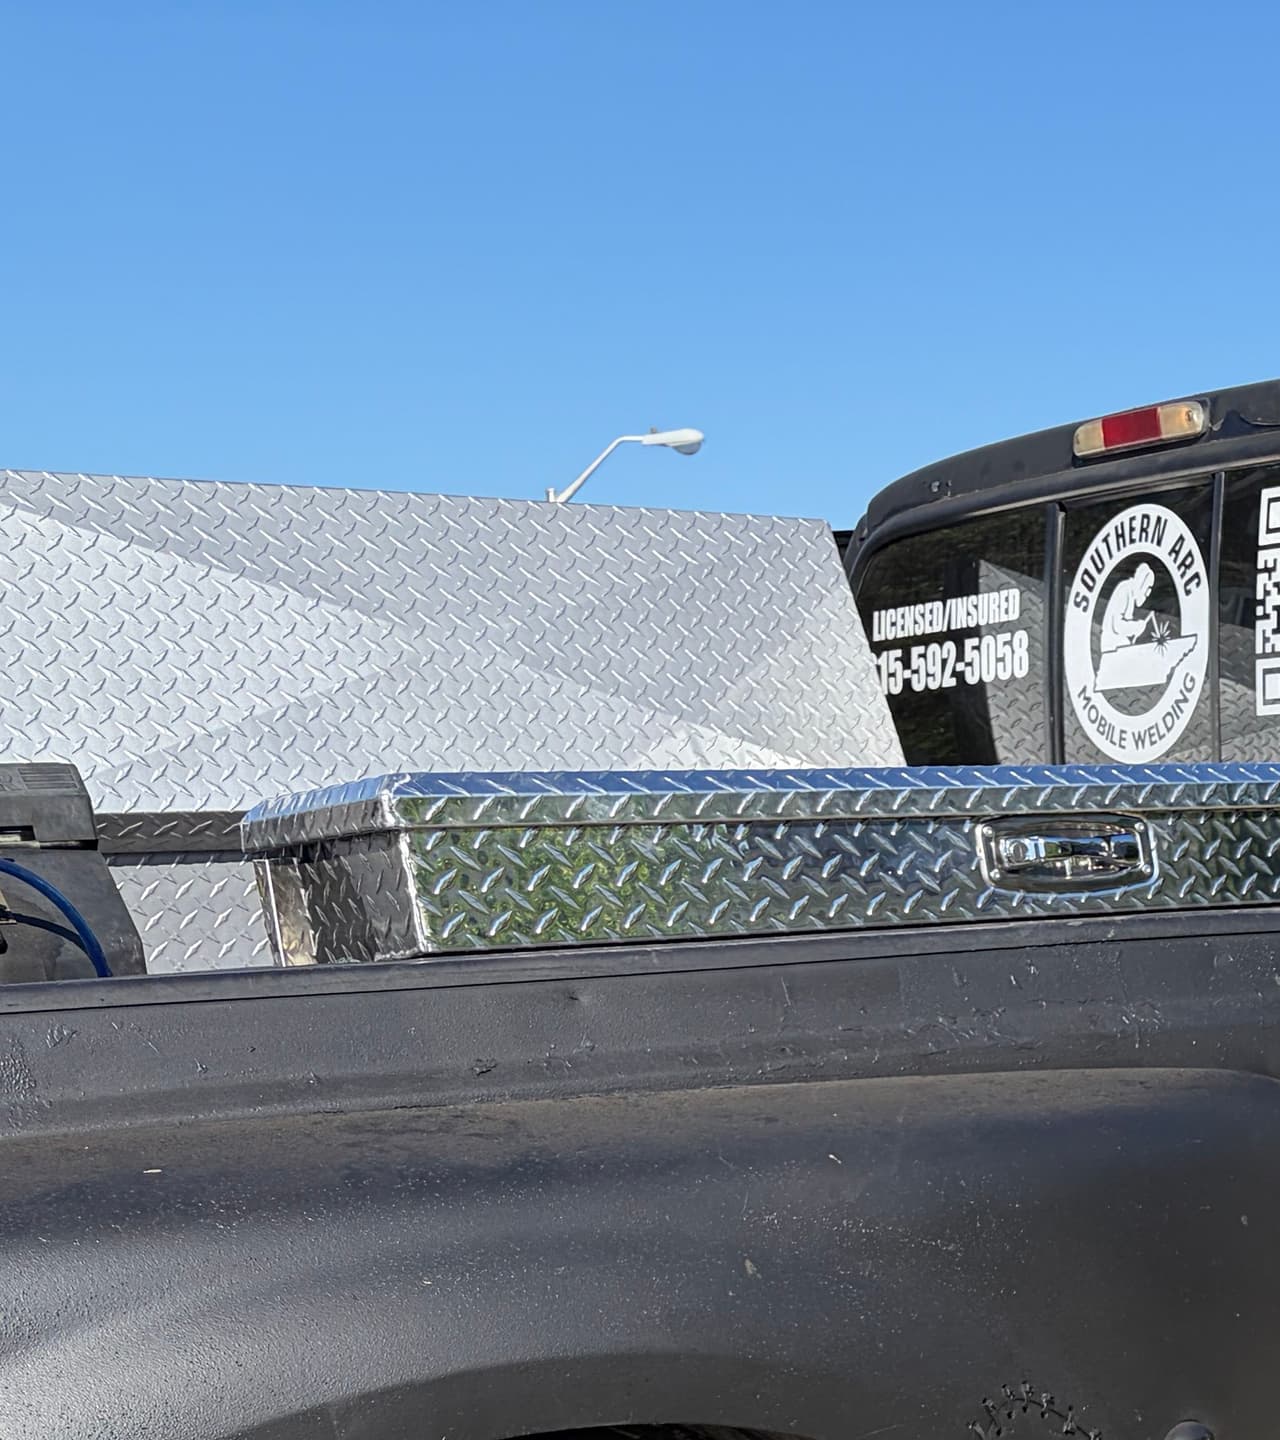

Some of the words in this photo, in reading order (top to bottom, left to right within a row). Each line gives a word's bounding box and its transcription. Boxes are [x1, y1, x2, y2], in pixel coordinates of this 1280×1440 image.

[1074, 513, 1168, 613] SOUTHERN
[1169, 533, 1200, 597] ARC
[872, 588, 1021, 642] LICENSED/INSURED
[872, 629, 1030, 696] 15-592-5058
[1077, 685, 1127, 750] MOBILE
[1131, 671, 1196, 751] WELDING
